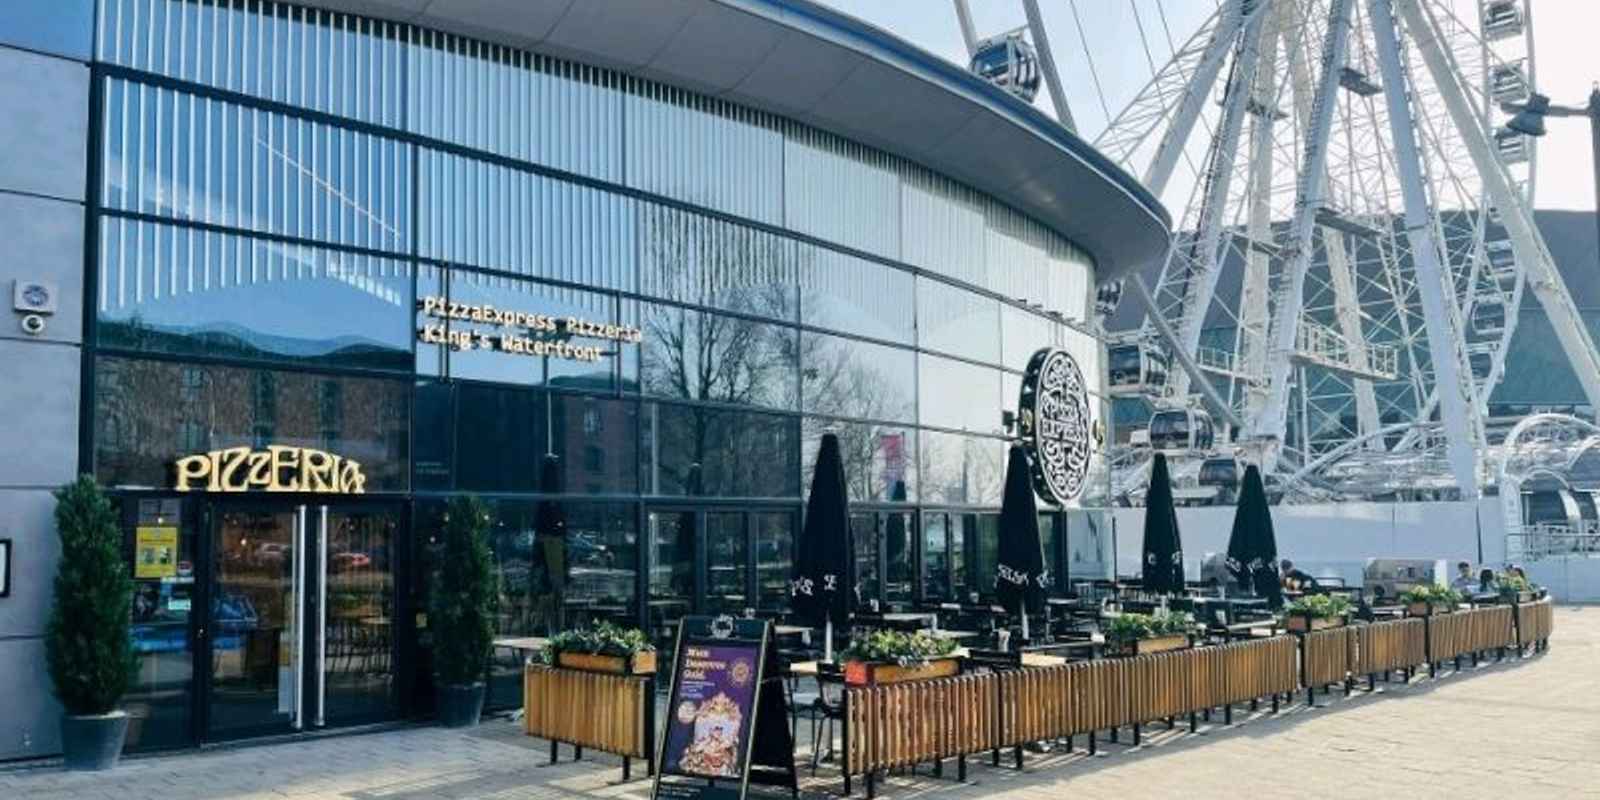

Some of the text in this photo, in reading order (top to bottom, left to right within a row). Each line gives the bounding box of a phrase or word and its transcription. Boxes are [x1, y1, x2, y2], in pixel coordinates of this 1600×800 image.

[422, 324, 603, 362] King's Waterfront
[423, 296, 643, 343] PizzaExpress Pizzeria
[175, 445, 366, 493] PIZZERIA
